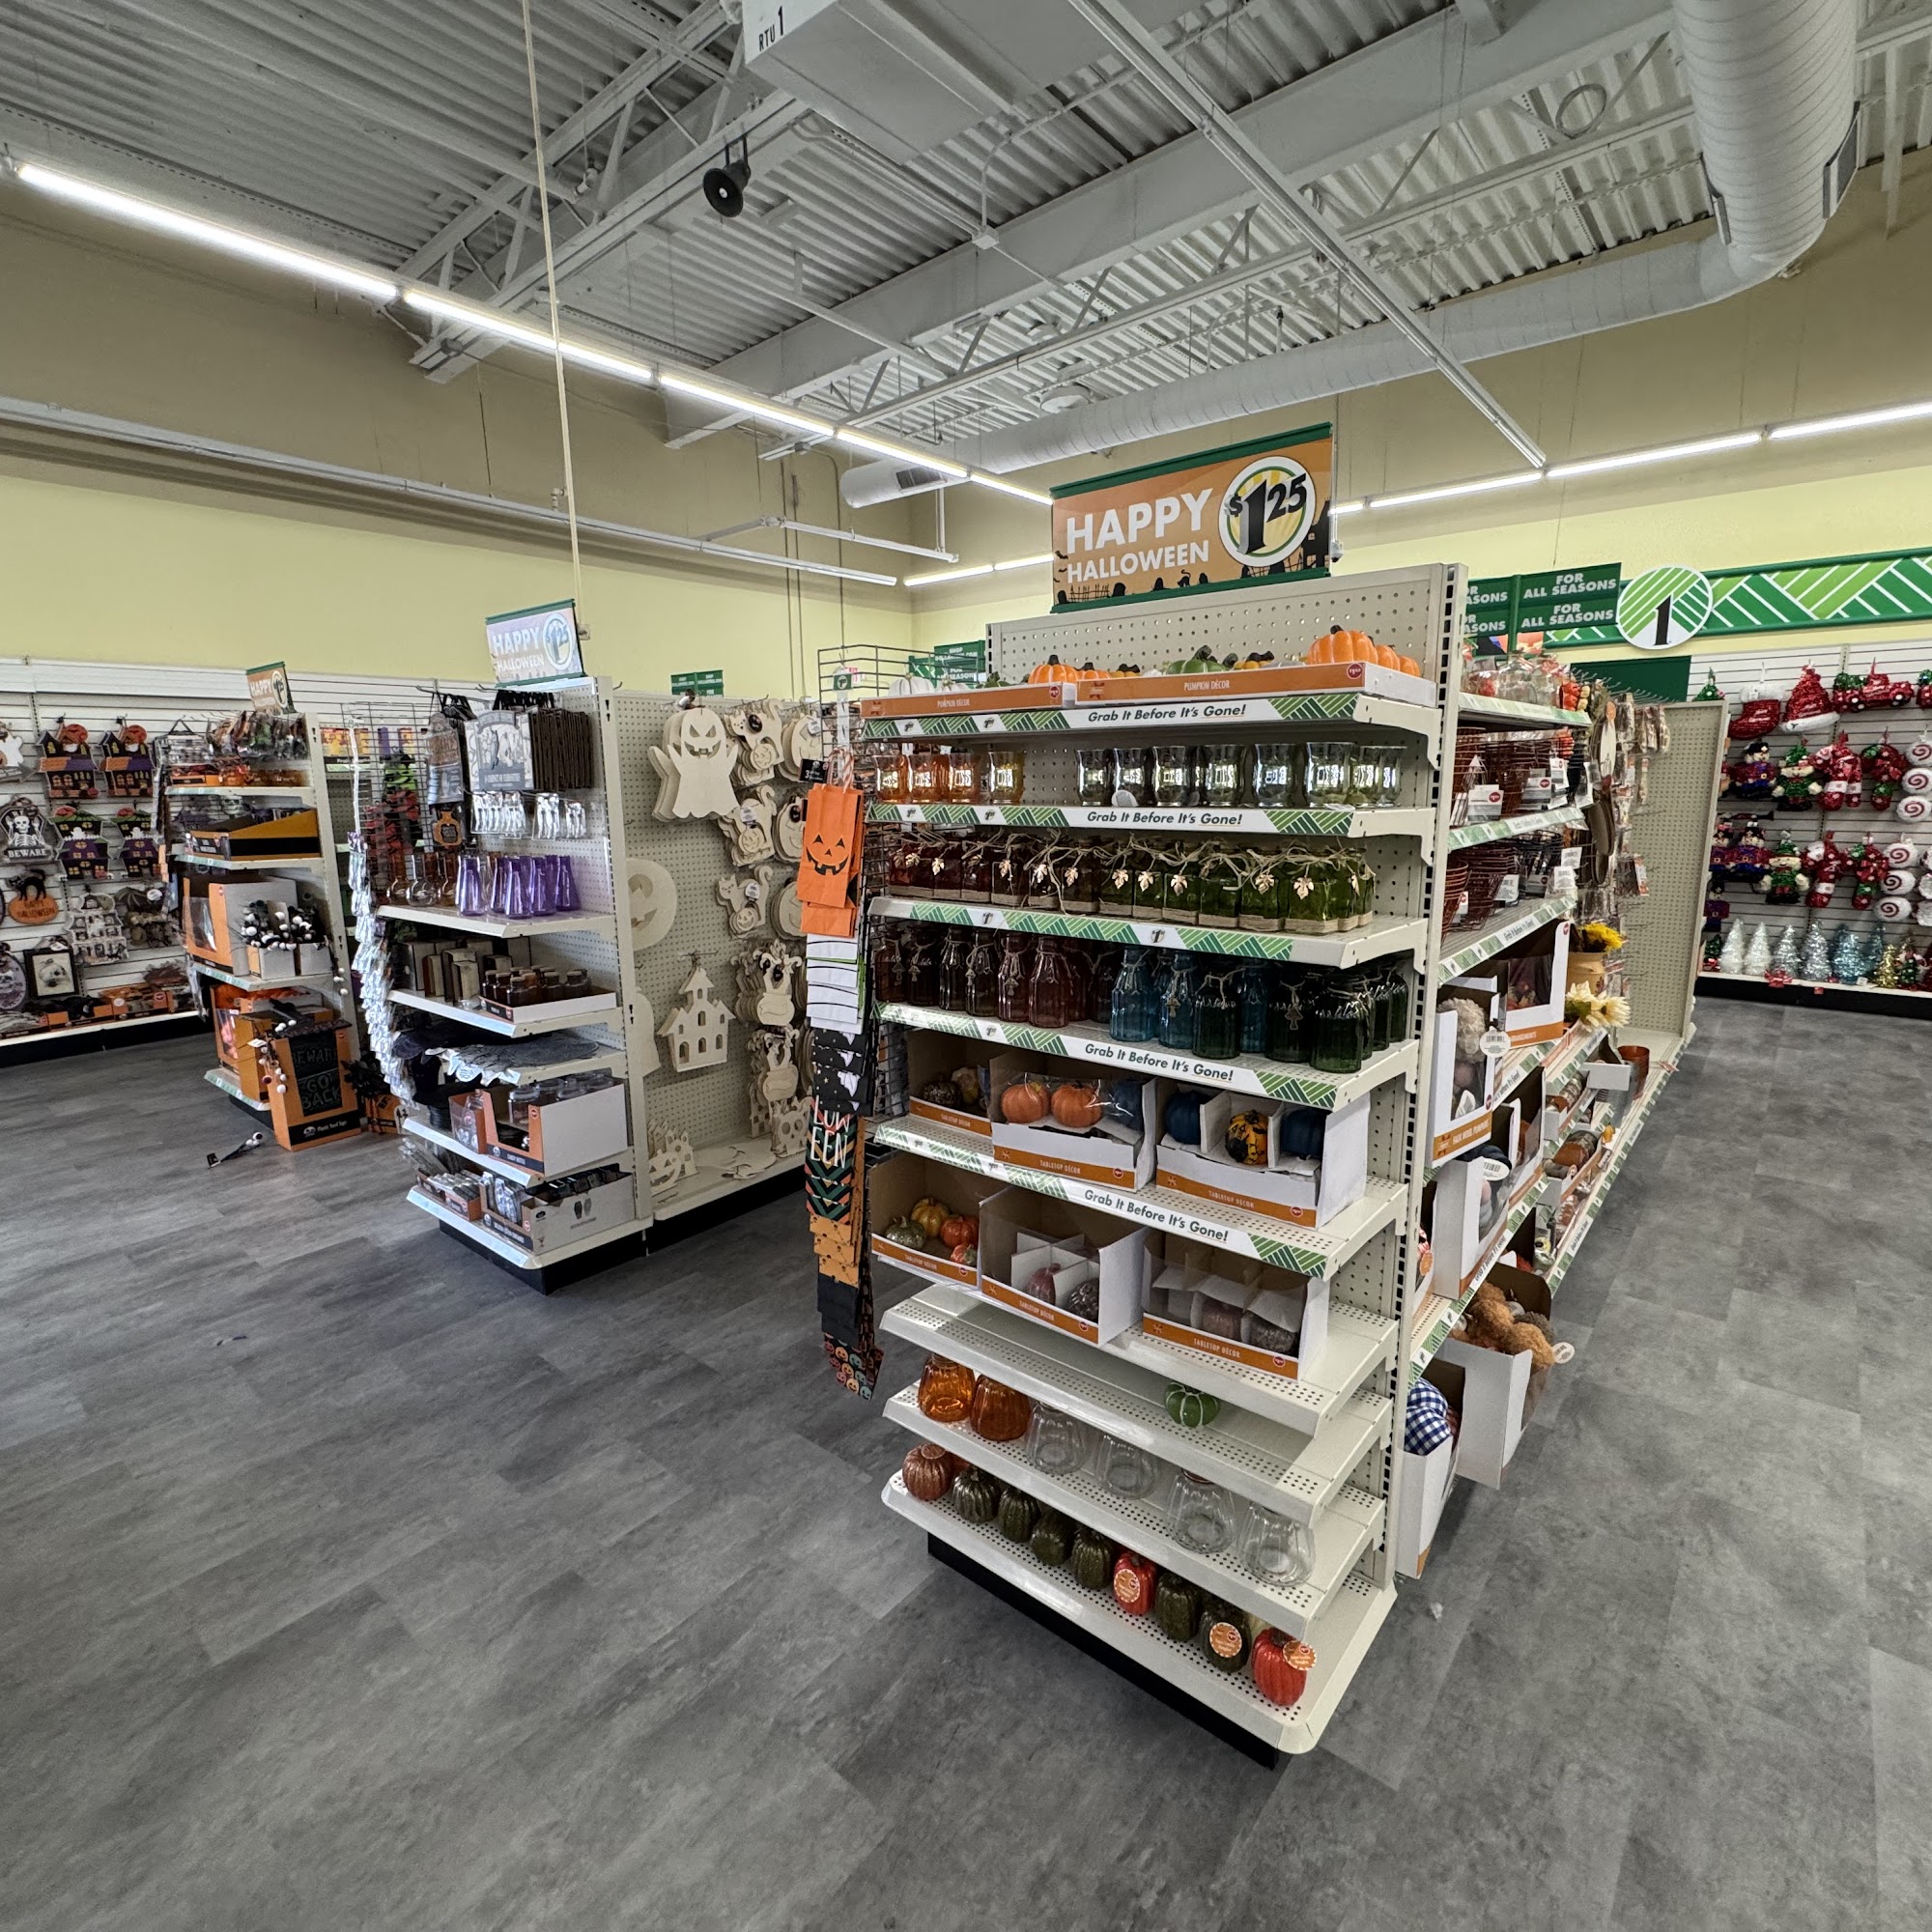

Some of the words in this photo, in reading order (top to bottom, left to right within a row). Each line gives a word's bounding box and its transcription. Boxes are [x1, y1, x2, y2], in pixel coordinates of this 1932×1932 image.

[758, 24, 776, 51] RTU
[778, 6, 784, 36] 1
[1066, 488, 1213, 554] HAPPY
[1067, 540, 1209, 583] HALLOWEEN
[1556, 573, 1584, 584] FOR
[1466, 591, 1508, 605] ASONS
[1523, 587, 1548, 599] ALL
[1551, 579, 1616, 595] SEASONS
[1553, 603, 1581, 614] FOR
[1464, 621, 1506, 633] ASONS
[1520, 616, 1545, 628] ALL
[1549, 610, 1614, 625] SEASONS
[492, 627, 540, 655] HAPPY
[497, 653, 545, 672] HALLOWEEN
[249, 678, 272, 696] HAPPY
[1184, 680, 1209, 692] PUMPKIN
[1210, 678, 1230, 689] DÉCOR
[1088, 711, 1118, 723] Grab
[1122, 709, 1131, 721] It
[1134, 707, 1176, 720] Before
[1180, 706, 1199, 718] It's
[1203, 704, 1246, 717] Gone!
[1087, 811, 1118, 823] Grab
[1121, 812, 1130, 823] It
[1132, 811, 1175, 824] Before
[1178, 811, 1196, 824] It's
[1200, 813, 1242, 825] Gone!
[8, 849, 47, 858] BEWARE
[1085, 1043, 1115, 1059] Grab
[1117, 1049, 1126, 1061] It
[1128, 1051, 1169, 1068] Before
[1172, 1060, 1189, 1072] It's
[1193, 1064, 1235, 1081] Gone!
[810, 1125, 848, 1169] EEN
[1040, 1159, 1063, 1170] TABLETOP
[1208, 1190, 1235, 1202] TABLETOP
[1084, 1189, 1112, 1207] Grab
[1116, 1198, 1124, 1210] It
[1126, 1202, 1165, 1222] Before
[1168, 1214, 1185, 1229] It's
[1189, 1221, 1229, 1241] Gone!
[1019, 1299, 1039, 1314] TABLETOP
[1194, 1338, 1220, 1351] TABLETOP
[1222, 1346, 1240, 1358] DÉCOR
